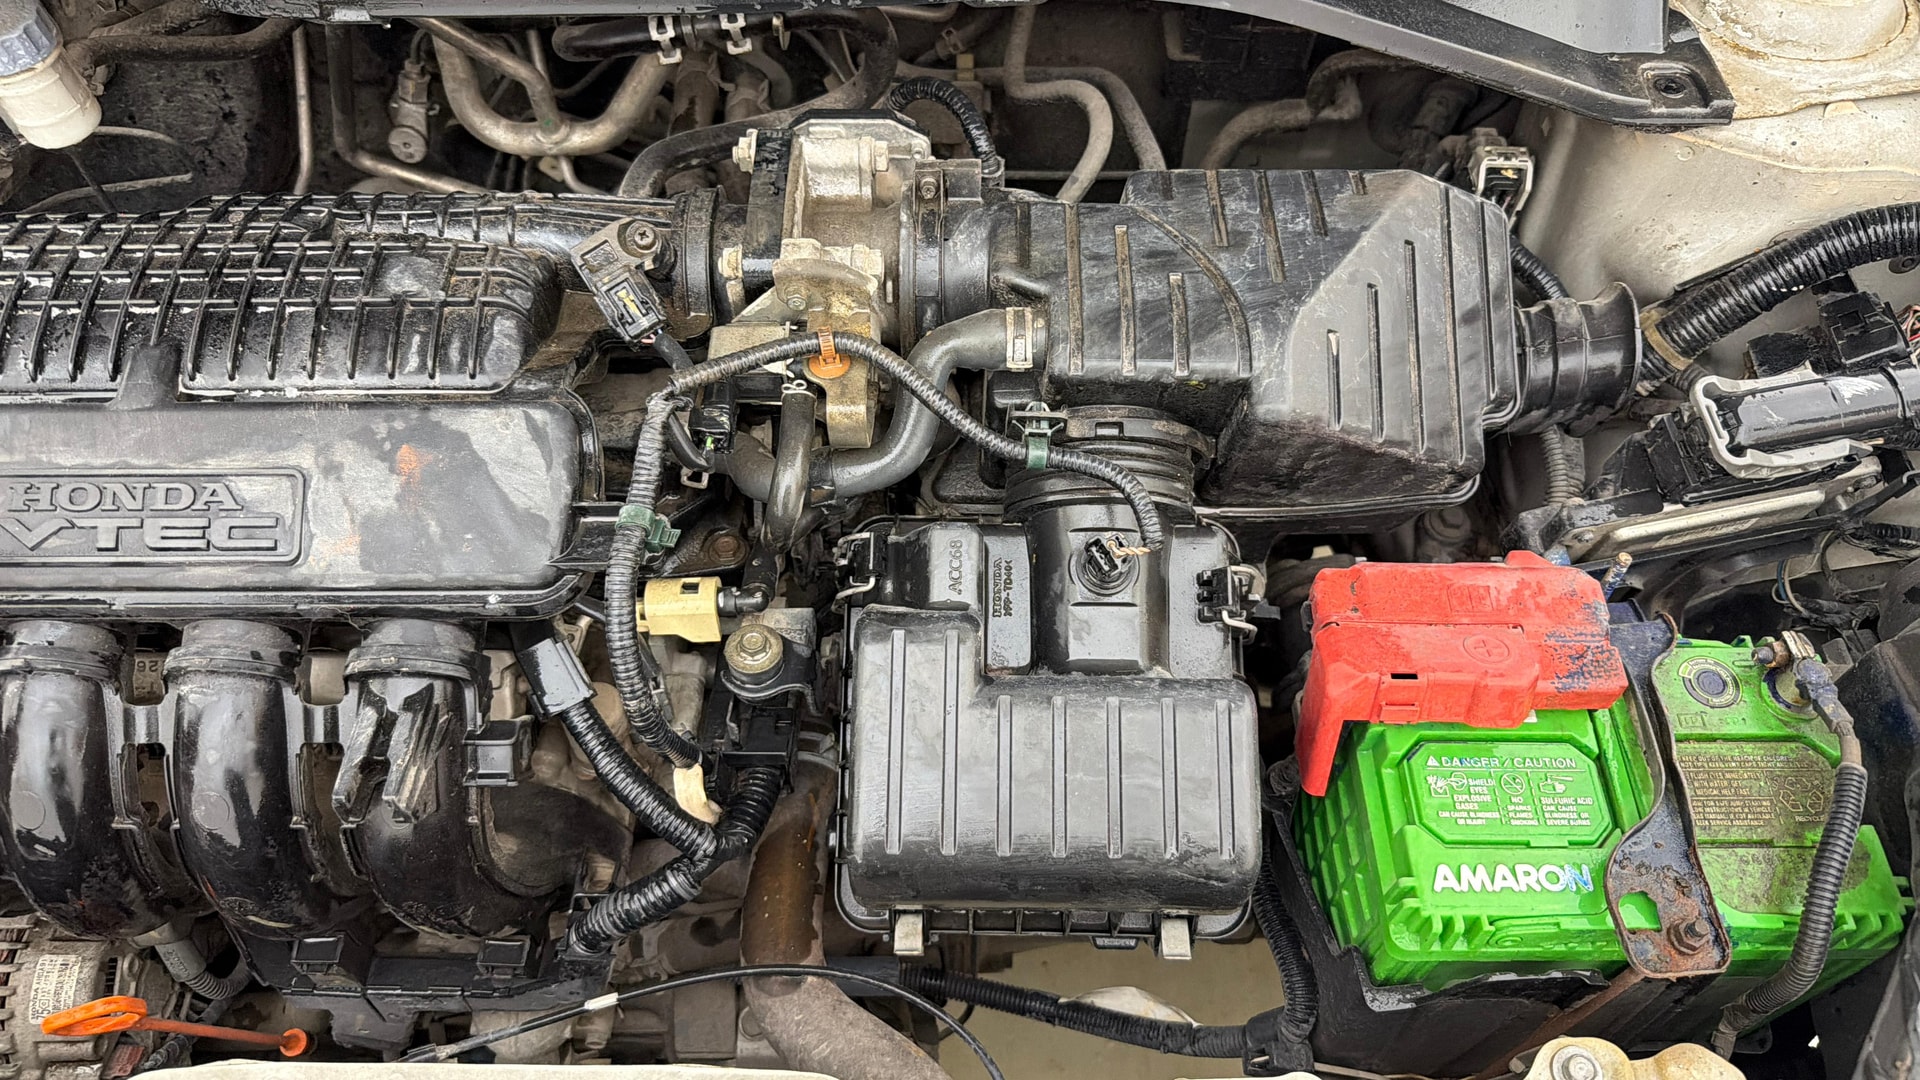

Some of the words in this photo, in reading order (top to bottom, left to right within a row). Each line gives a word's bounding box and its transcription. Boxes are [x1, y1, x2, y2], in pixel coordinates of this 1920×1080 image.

[8, 483, 243, 512] HONDA
[0, 517, 278, 551] VTEC
[948, 539, 963, 595] ACC68
[993, 557, 1002, 618] HONDA
[1441, 756, 1500, 767] DANGER
[1513, 757, 1576, 768] CAUTION
[1469, 778, 1495, 786] SHIELD
[1470, 786, 1489, 794] EYES
[1453, 794, 1491, 802] EXPLOSIVE
[1455, 802, 1479, 810] GASES
[1540, 796, 1576, 805] SULFURIC
[1577, 797, 1593, 805] ACID
[1433, 863, 1594, 893] AMARON
[31, 987, 40, 1020] HONDA
